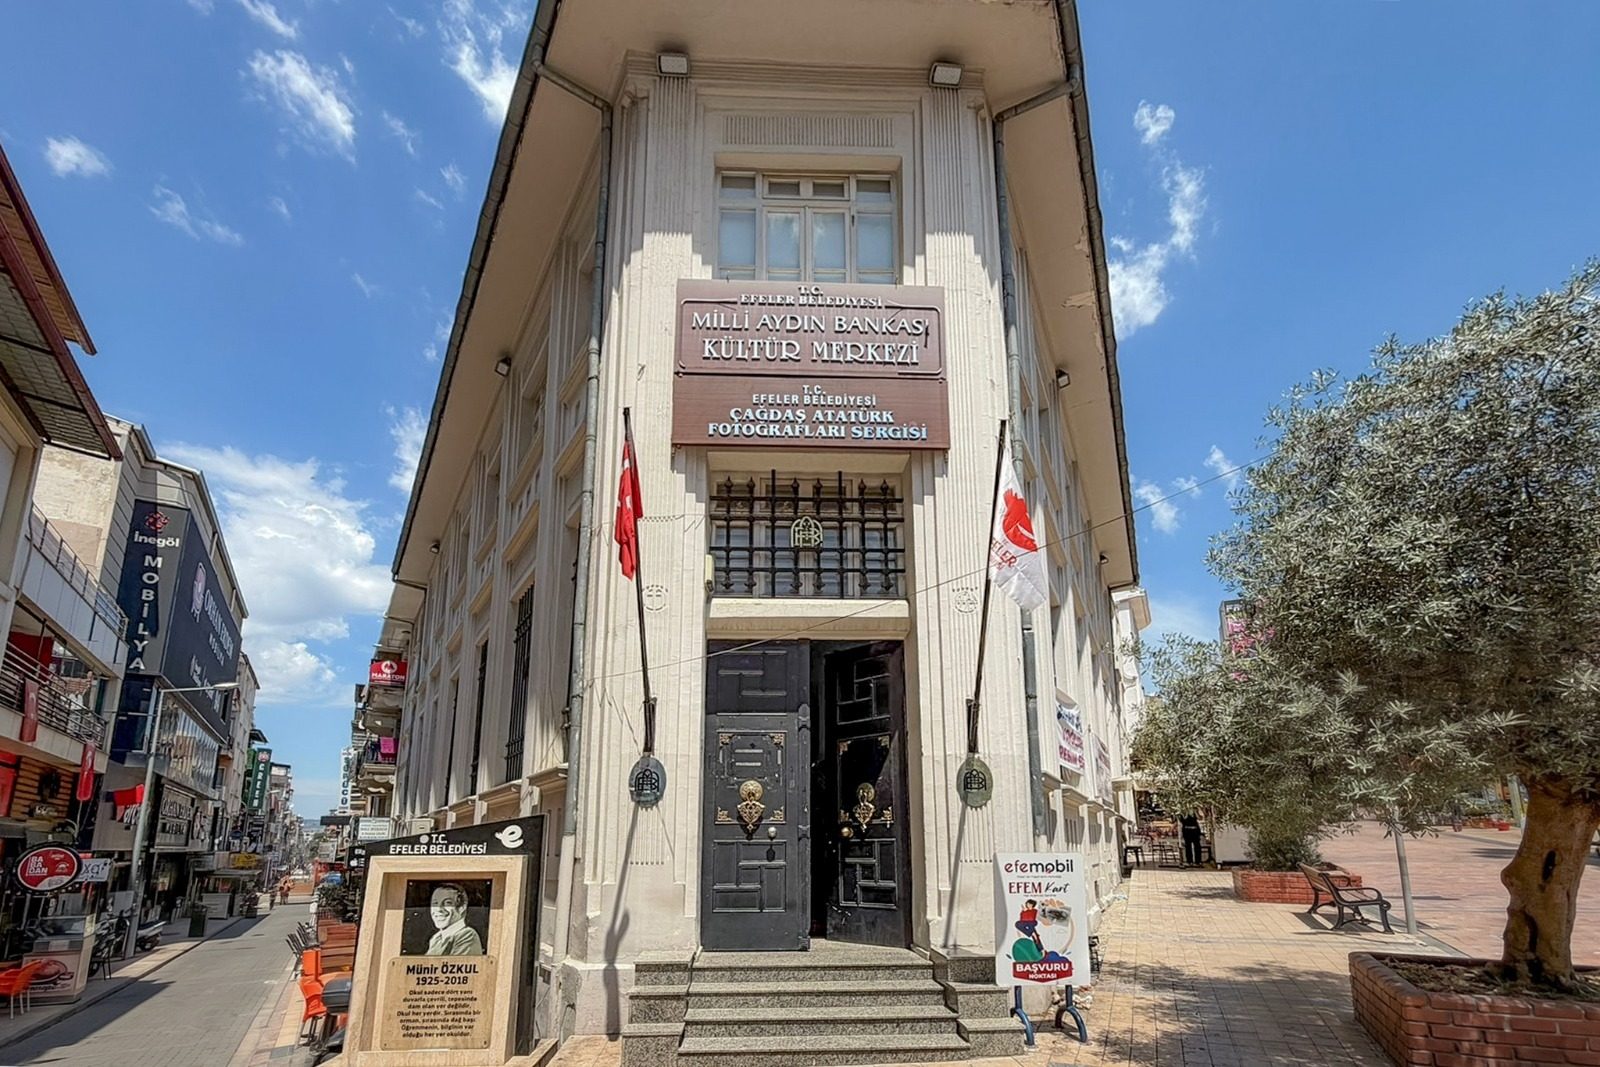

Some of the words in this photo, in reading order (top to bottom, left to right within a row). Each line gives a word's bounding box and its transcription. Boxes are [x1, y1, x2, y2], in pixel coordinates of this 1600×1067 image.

[797, 285, 823, 296] T.C.
[740, 294, 795, 306] EFELER
[798, 294, 882, 308] BELEDİYESİ
[692, 310, 749, 330] MİLLİ
[756, 314, 826, 333] AYDIN
[703, 336, 800, 361] KÜLTÜR
[811, 340, 919, 366] MERKEZİ
[802, 385, 826, 395] T.C.
[752, 394, 799, 406] EFELER
[803, 394, 876, 407] BELEDİYESİ
[730, 405, 806, 424] ÇAĞDAŞ
[812, 407, 894, 425] ATATÜRK
[708, 422, 846, 439] FOTOĞRAFLARI
[851, 423, 928, 440] SERGİSİ
[129, 554, 163, 670] MOBİLYA
[431, 833, 447, 844] T.C.
[389, 844, 428, 855] EFELER
[429, 842, 487, 854] BELEDİYESİ
[1004, 859, 1074, 874] efemobil
[1008, 881, 1042, 894] EFEM
[1044, 881, 1070, 894] Kart
[406, 964, 439, 975] Münir
[440, 961, 479, 975] ÖZKUL
[1015, 963, 1069, 974] BAŞVURU
[416, 976, 469, 985] 1925-2018
